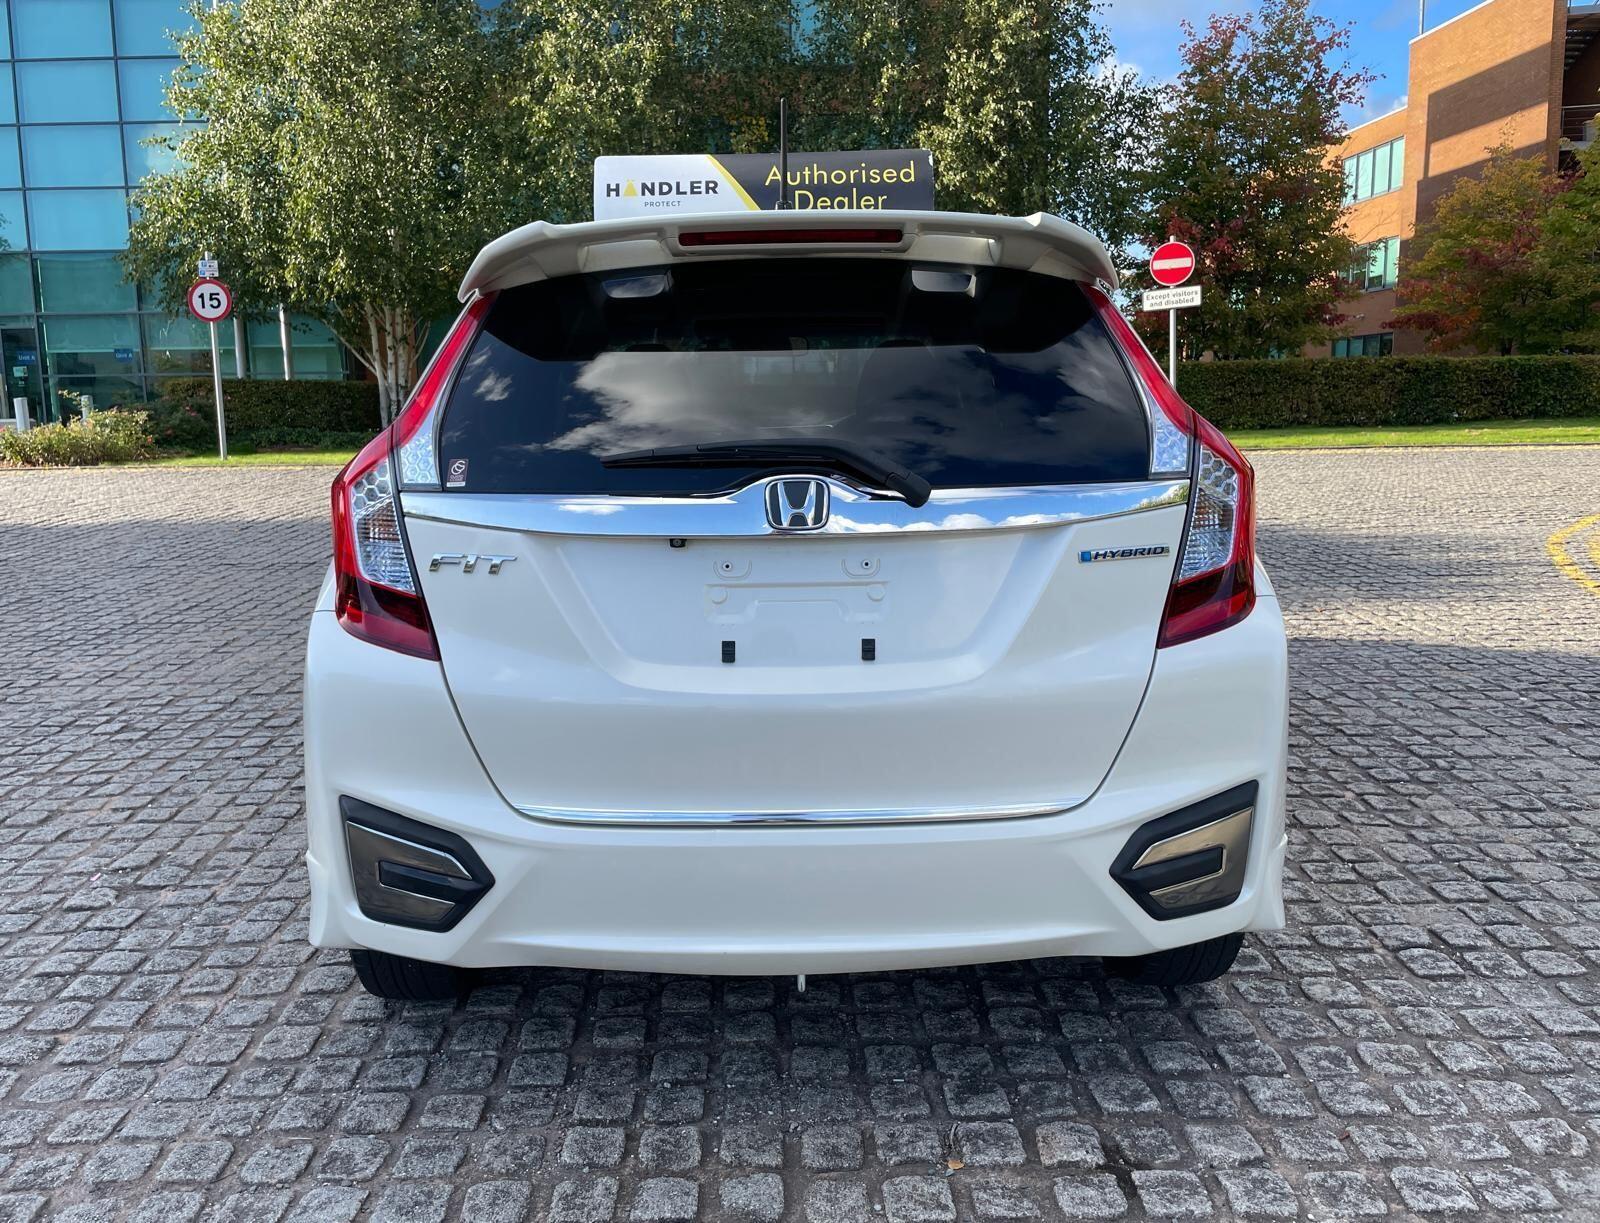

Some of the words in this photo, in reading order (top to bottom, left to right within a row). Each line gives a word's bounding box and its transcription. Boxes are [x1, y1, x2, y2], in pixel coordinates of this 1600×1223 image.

[764, 159, 915, 186] Authorised
[606, 179, 719, 197] HANDLER
[644, 200, 681, 208] PROTECT
[794, 187, 888, 210] Dealer
[198, 292, 222, 309] 15
[1146, 292, 1170, 301] Except
[1172, 289, 1198, 298] visitors
[1164, 296, 1195, 306] disabled
[1093, 546, 1165, 560] HYBRID
[429, 552, 519, 575] FIT
